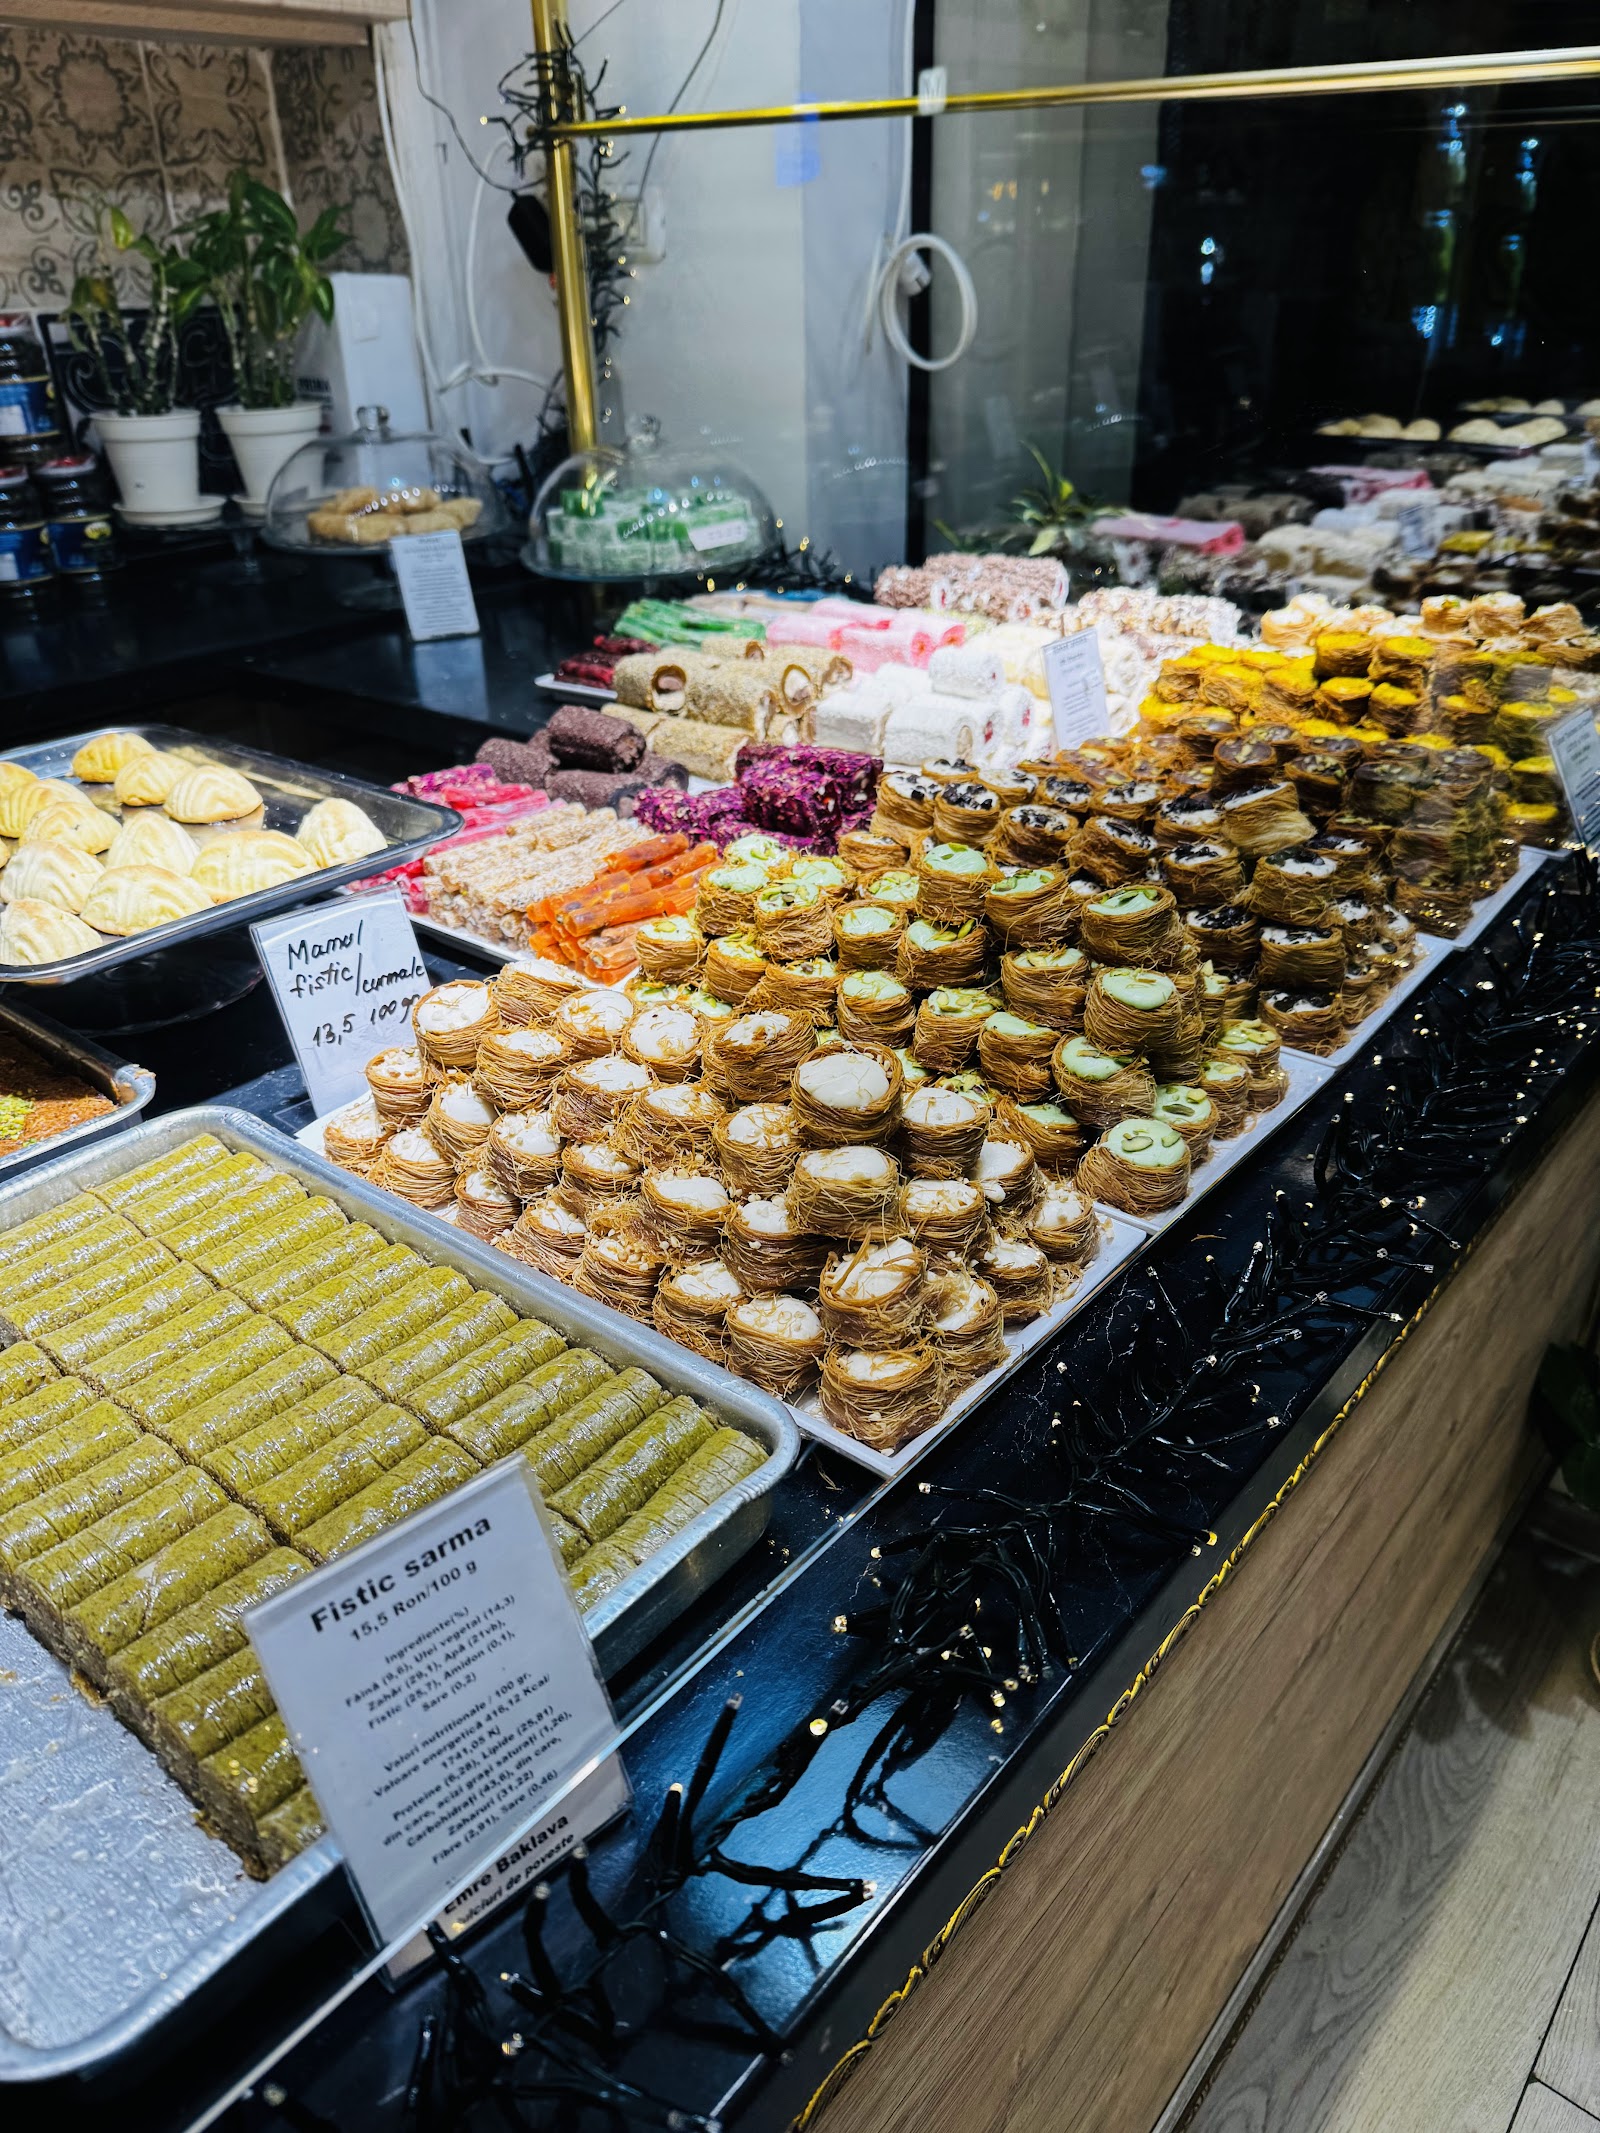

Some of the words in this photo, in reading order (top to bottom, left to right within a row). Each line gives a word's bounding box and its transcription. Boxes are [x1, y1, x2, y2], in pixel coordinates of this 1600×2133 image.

[312, 1013, 356, 1047] 13,5
[370, 999, 398, 1025] 100
[310, 1574, 396, 1633] Fistic
[404, 1518, 491, 1578] sarma
[351, 1611, 389, 1641] 15,5
[392, 1567, 461, 1617] Ron/100
[465, 1560, 477, 1575] g
[384, 1606, 469, 1665] Ingrediente(%)
[368, 1705, 402, 1730] Fistic
[444, 1873, 493, 1915] Emre
[496, 1815, 569, 1874] Baklava
[458, 1886, 503, 1924] ulciuri
[525, 1834, 575, 1879] poveste
